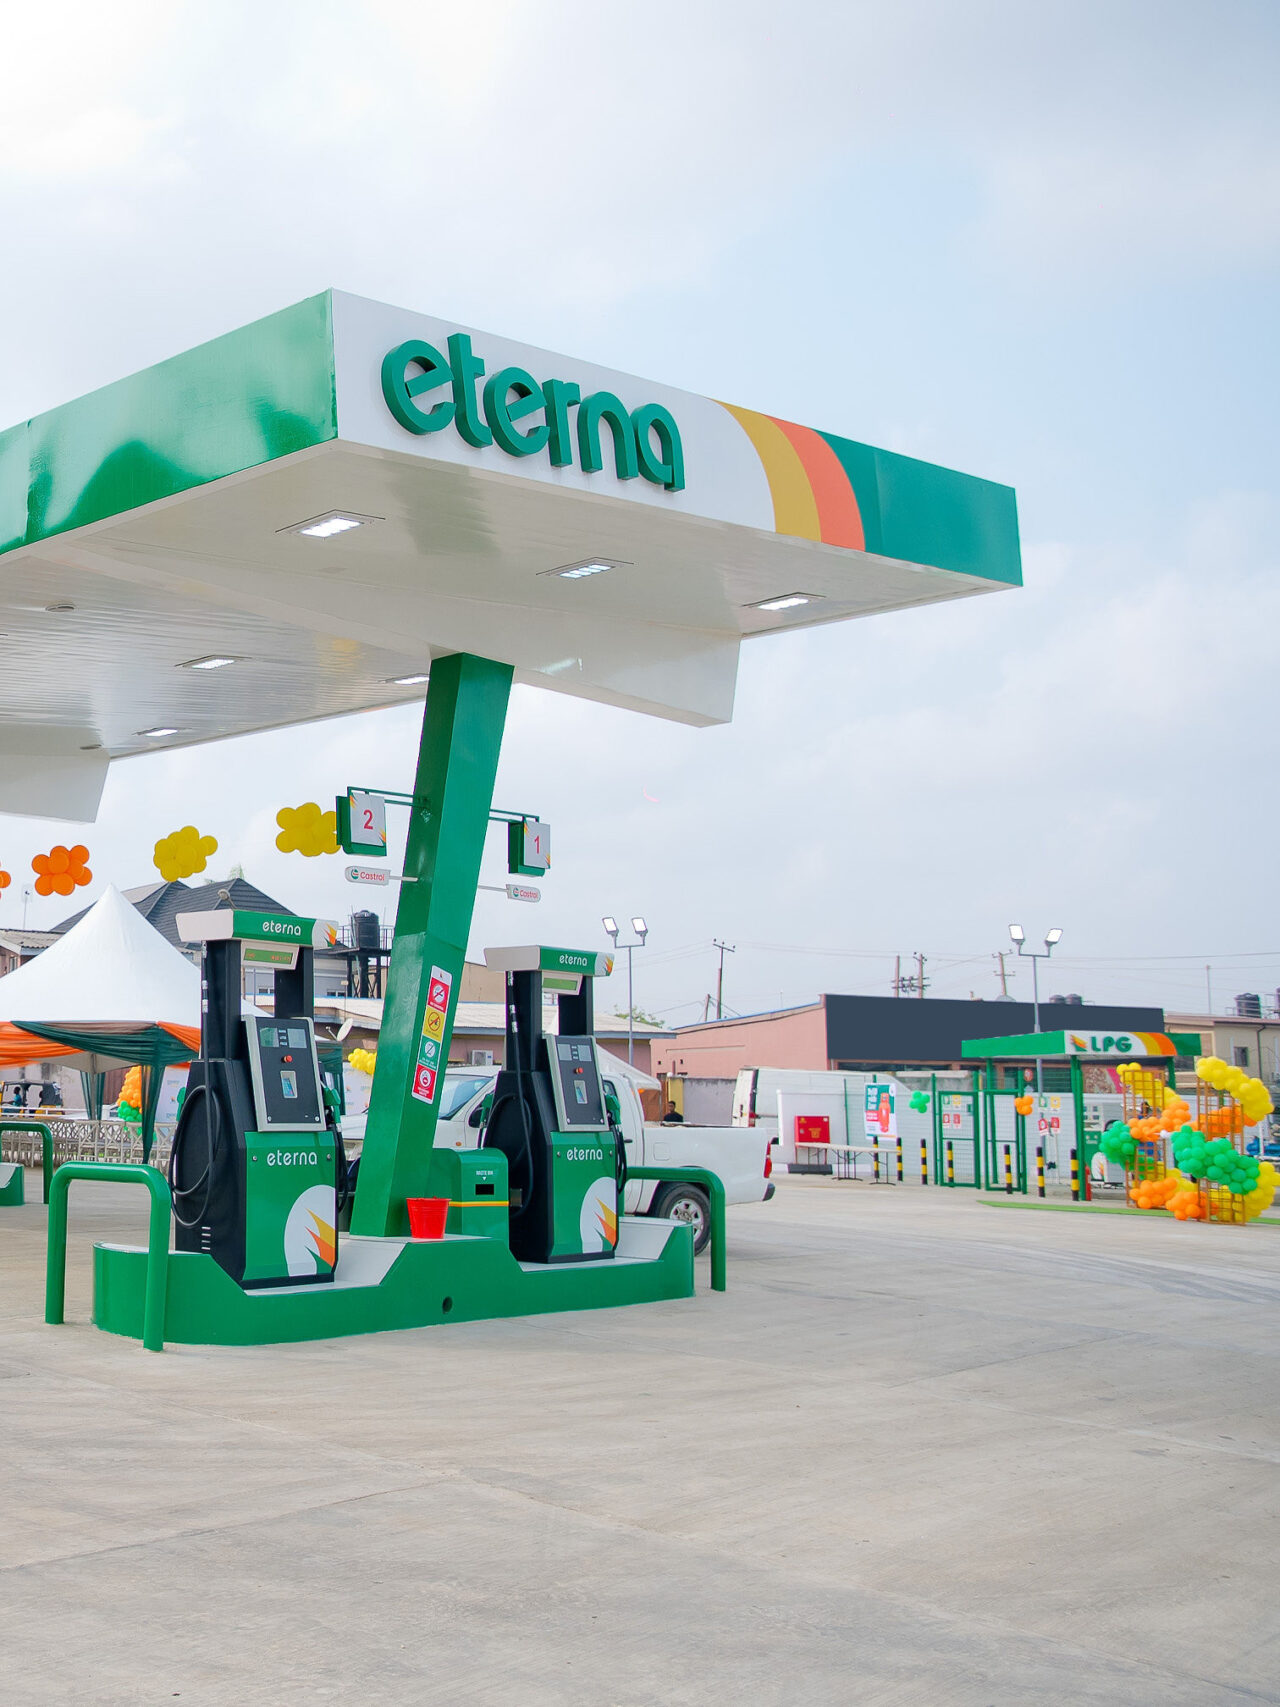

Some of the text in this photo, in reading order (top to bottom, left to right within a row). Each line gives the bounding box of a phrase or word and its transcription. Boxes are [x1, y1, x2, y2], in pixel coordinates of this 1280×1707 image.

[381, 332, 685, 492] eterna
[363, 809, 374, 830] 2
[534, 835, 541, 854] 1
[360, 871, 385, 881] Castrol
[520, 889, 539, 899] Castrol
[262, 920, 302, 936] eterna
[559, 953, 588, 967] eterna
[1090, 1036, 1132, 1053] LPG
[266, 1150, 318, 1167] eterna
[566, 1147, 603, 1161] eterna
